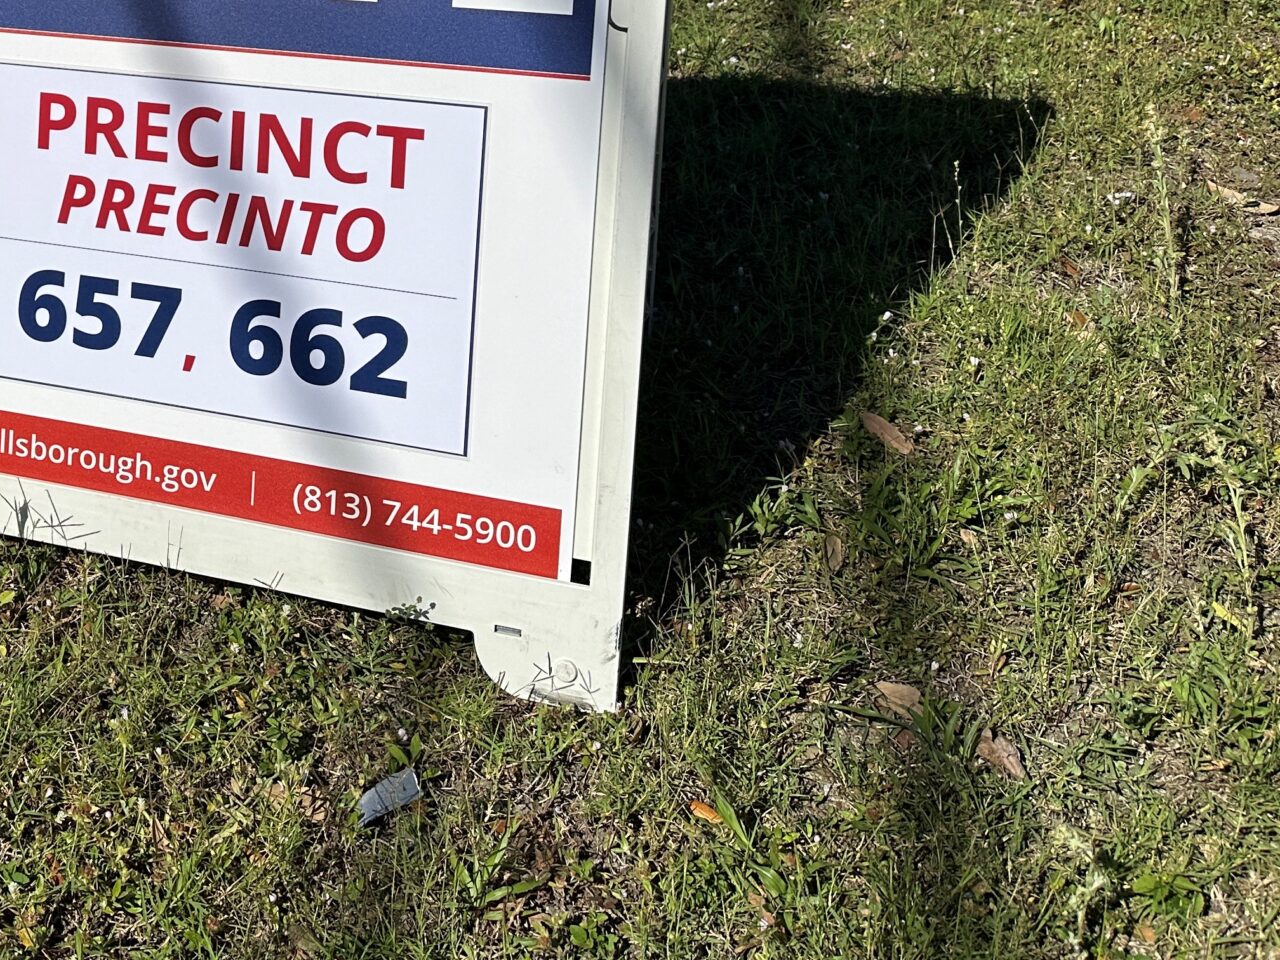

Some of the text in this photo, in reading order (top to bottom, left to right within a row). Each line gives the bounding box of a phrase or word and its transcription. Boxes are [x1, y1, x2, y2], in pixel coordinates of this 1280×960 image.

[37, 91, 425, 189] PRECINCT
[57, 174, 386, 263] PRECINTO
[18, 269, 409, 400] 657, 662
[292, 483, 372, 527] (813)
[381, 499, 537, 553] 744-5900
